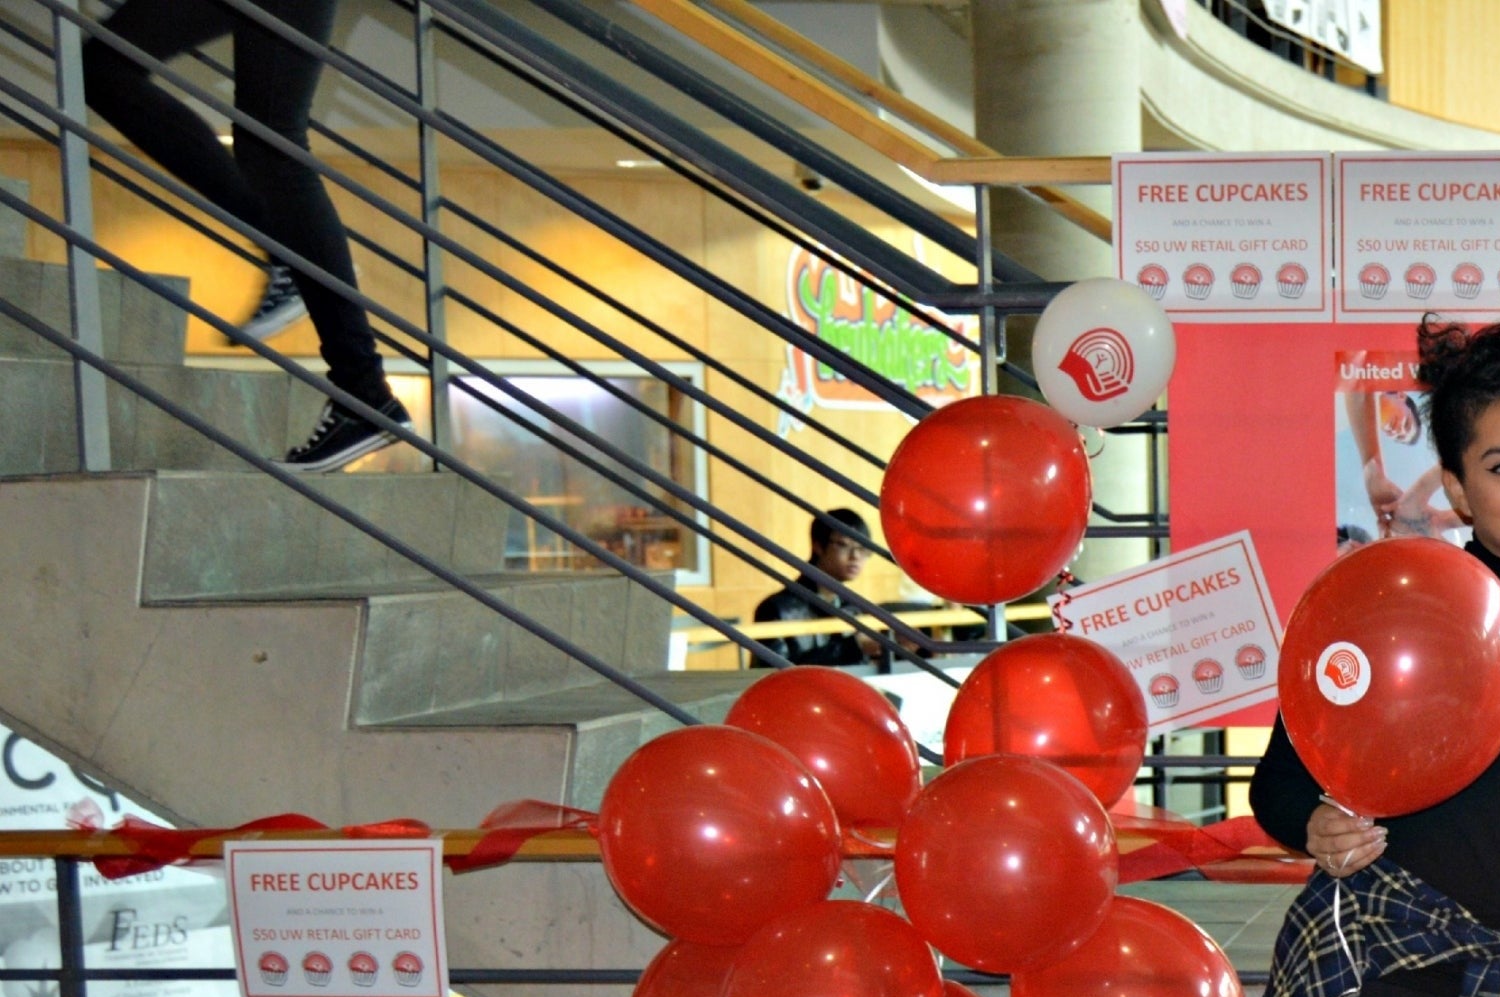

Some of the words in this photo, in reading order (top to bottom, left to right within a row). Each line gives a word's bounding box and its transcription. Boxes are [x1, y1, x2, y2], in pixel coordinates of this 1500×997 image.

[1138, 184, 1188, 203] FREE
[1196, 182, 1308, 202] CUPCAKES
[1360, 183, 1411, 202] FREE
[1135, 240, 1160, 253] $50
[1163, 240, 1187, 253] UW
[1191, 240, 1235, 252] RETAIL
[1238, 239, 1268, 252] GIFT
[1271, 239, 1308, 251] CARD
[1356, 238, 1382, 253] $50
[1384, 239, 1409, 252] UW
[1413, 238, 1457, 252] RETAIL
[1460, 239, 1490, 251] GIFT
[1340, 362, 1403, 380] United
[1080, 604, 1130, 635] FREE
[1134, 567, 1241, 617] CUPCAKES
[1146, 643, 1190, 665] RETAIL
[1190, 631, 1219, 650] GIFT
[1220, 619, 1256, 640] CARD
[250, 873, 301, 892] FREE
[307, 872, 418, 891] CUPCAKES
[252, 927, 276, 942] $50
[280, 928, 304, 941] UW
[307, 928, 350, 941] RETAIL
[353, 928, 382, 941] GIFT
[385, 928, 422, 941] CARD
